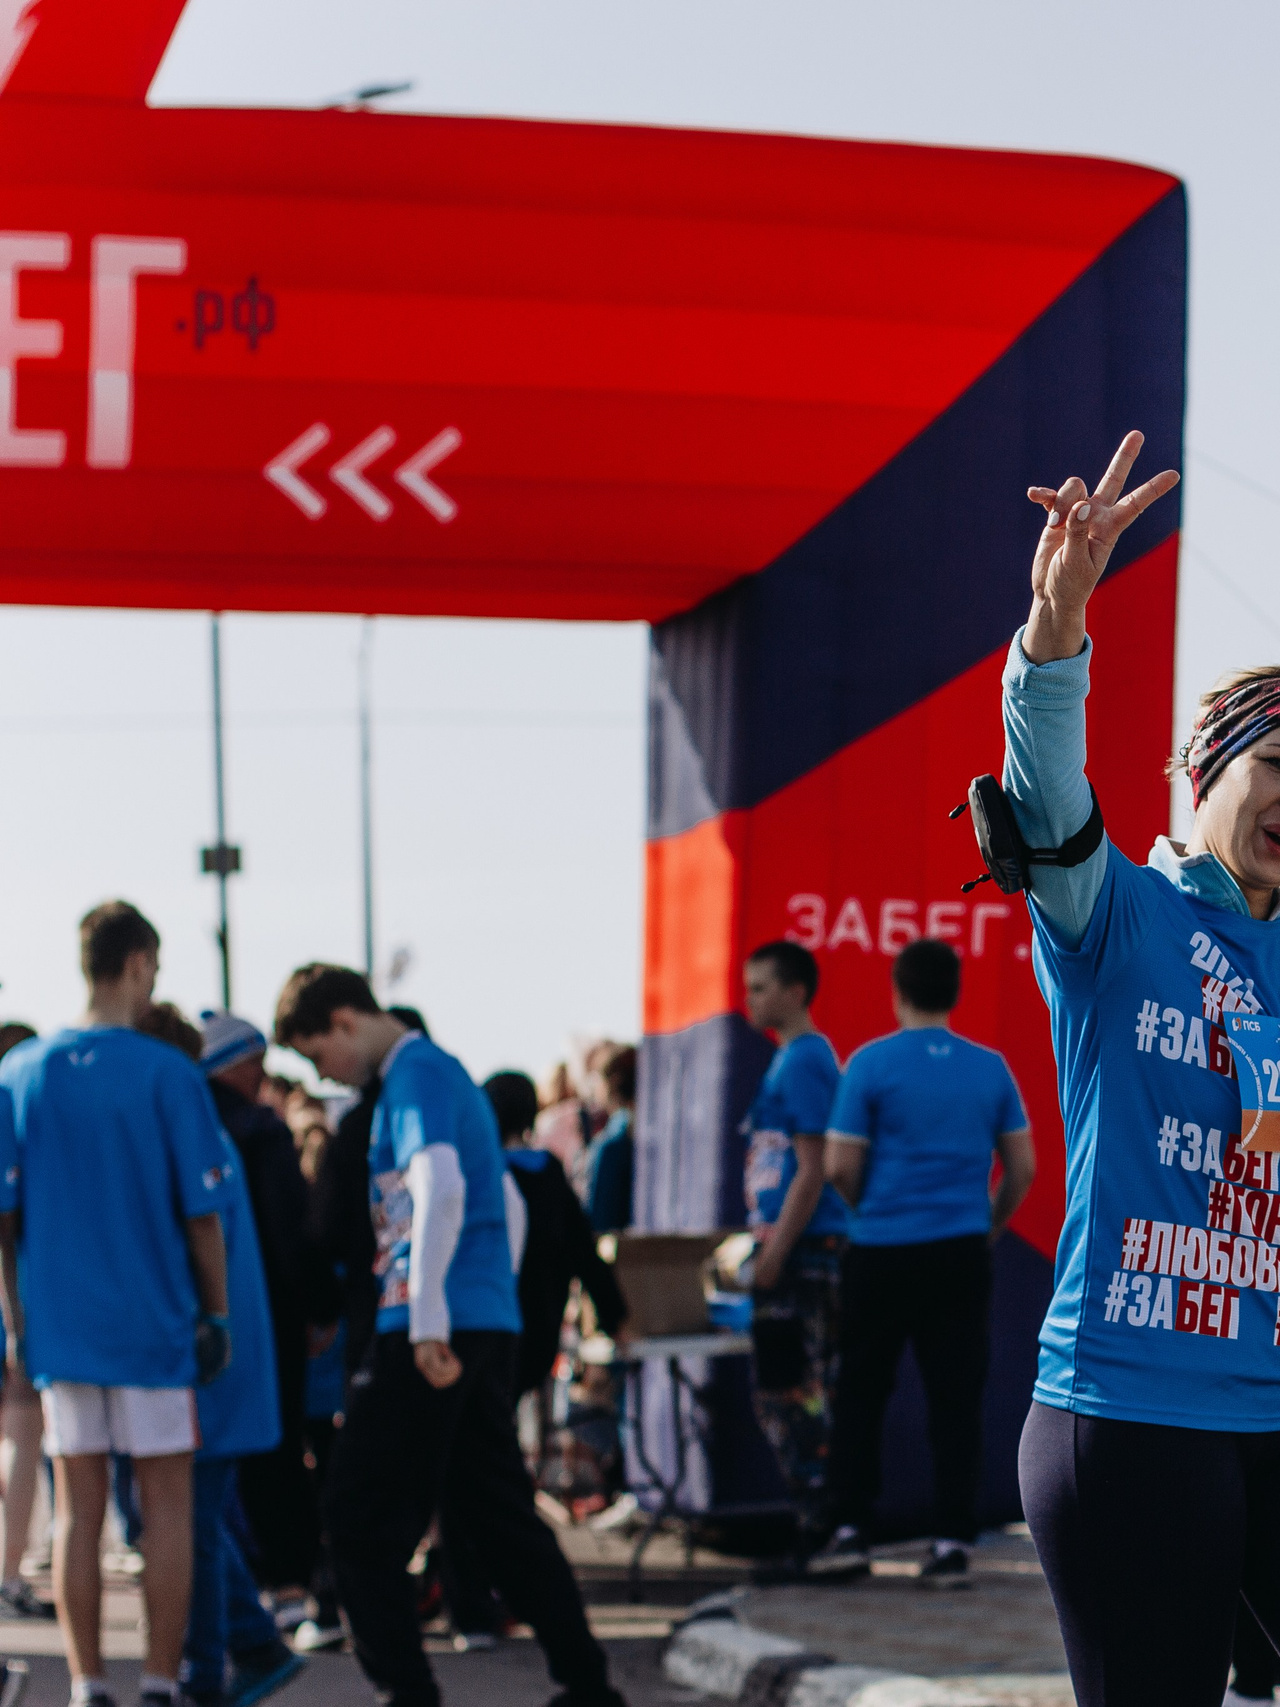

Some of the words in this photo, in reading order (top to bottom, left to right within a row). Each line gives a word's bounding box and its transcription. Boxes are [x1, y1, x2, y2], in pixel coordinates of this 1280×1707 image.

[1135, 999, 1238, 1080] #ЗАБ
[1243, 1020, 1261, 1032] ПСБ
[1104, 1271, 1240, 1340] #ЗАБЕГ
